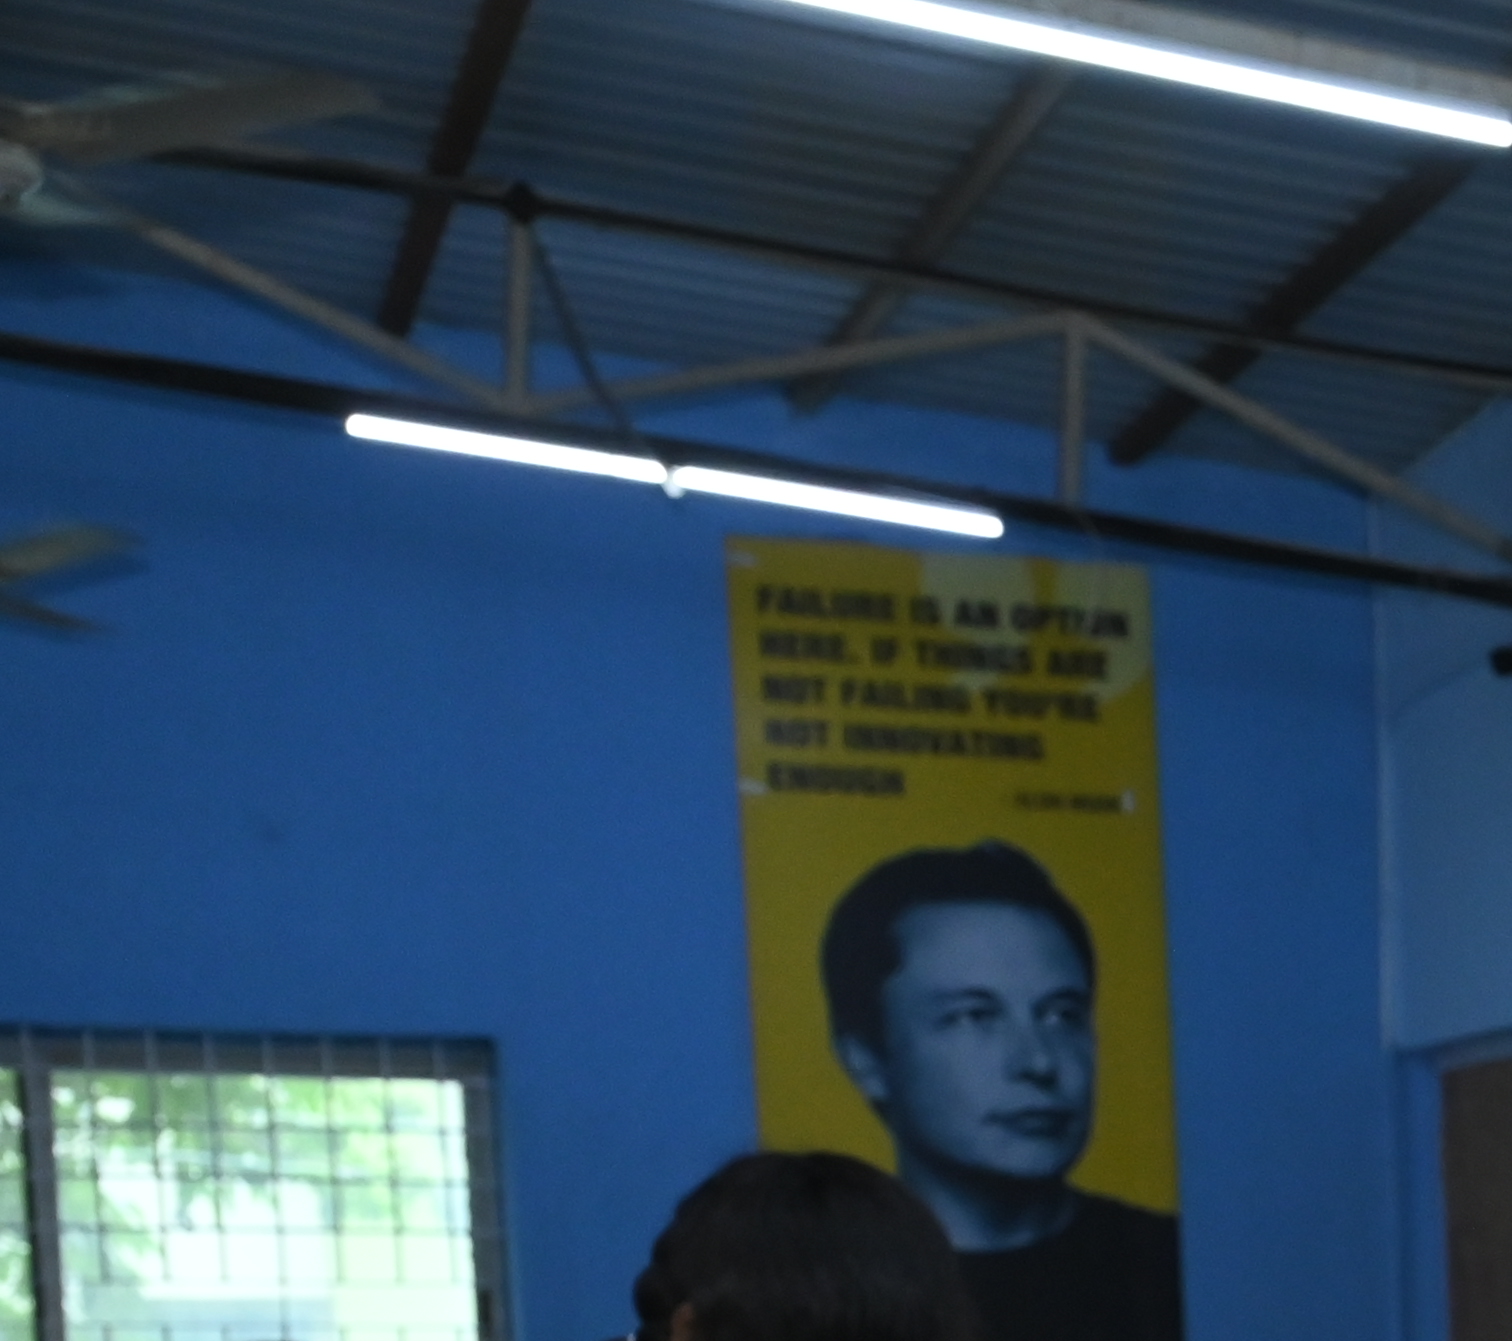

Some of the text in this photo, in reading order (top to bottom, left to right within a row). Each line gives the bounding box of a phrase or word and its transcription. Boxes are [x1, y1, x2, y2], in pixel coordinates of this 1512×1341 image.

[954, 598, 999, 629] AN
[1046, 648, 1108, 682] ARE
[762, 673, 825, 703] NOT
[765, 718, 828, 747] NOT
